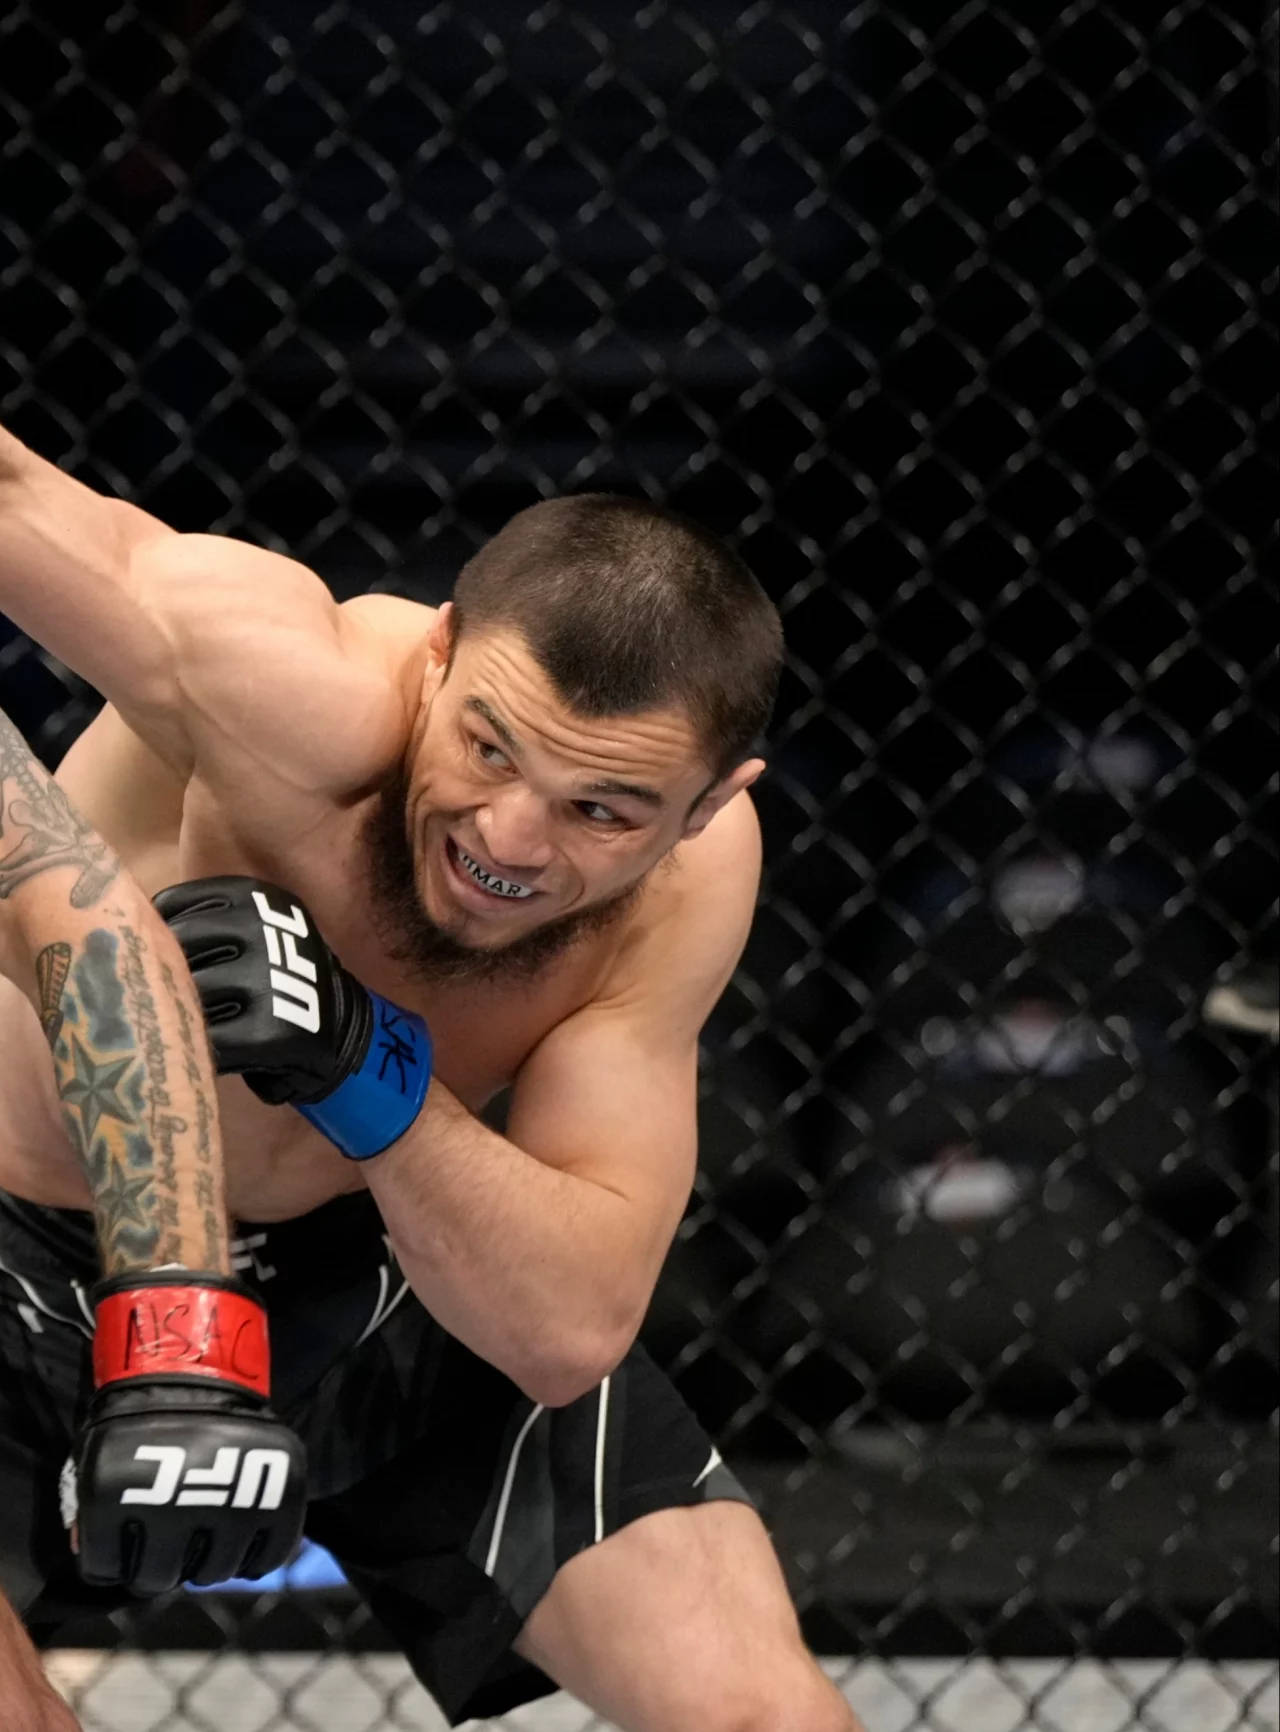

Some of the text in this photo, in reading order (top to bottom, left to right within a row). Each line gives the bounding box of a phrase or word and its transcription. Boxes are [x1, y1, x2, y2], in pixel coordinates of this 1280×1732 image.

[251, 890, 321, 1034] UFC
[123, 1302, 259, 1381] NSAC
[120, 1444, 291, 1510] UFC
